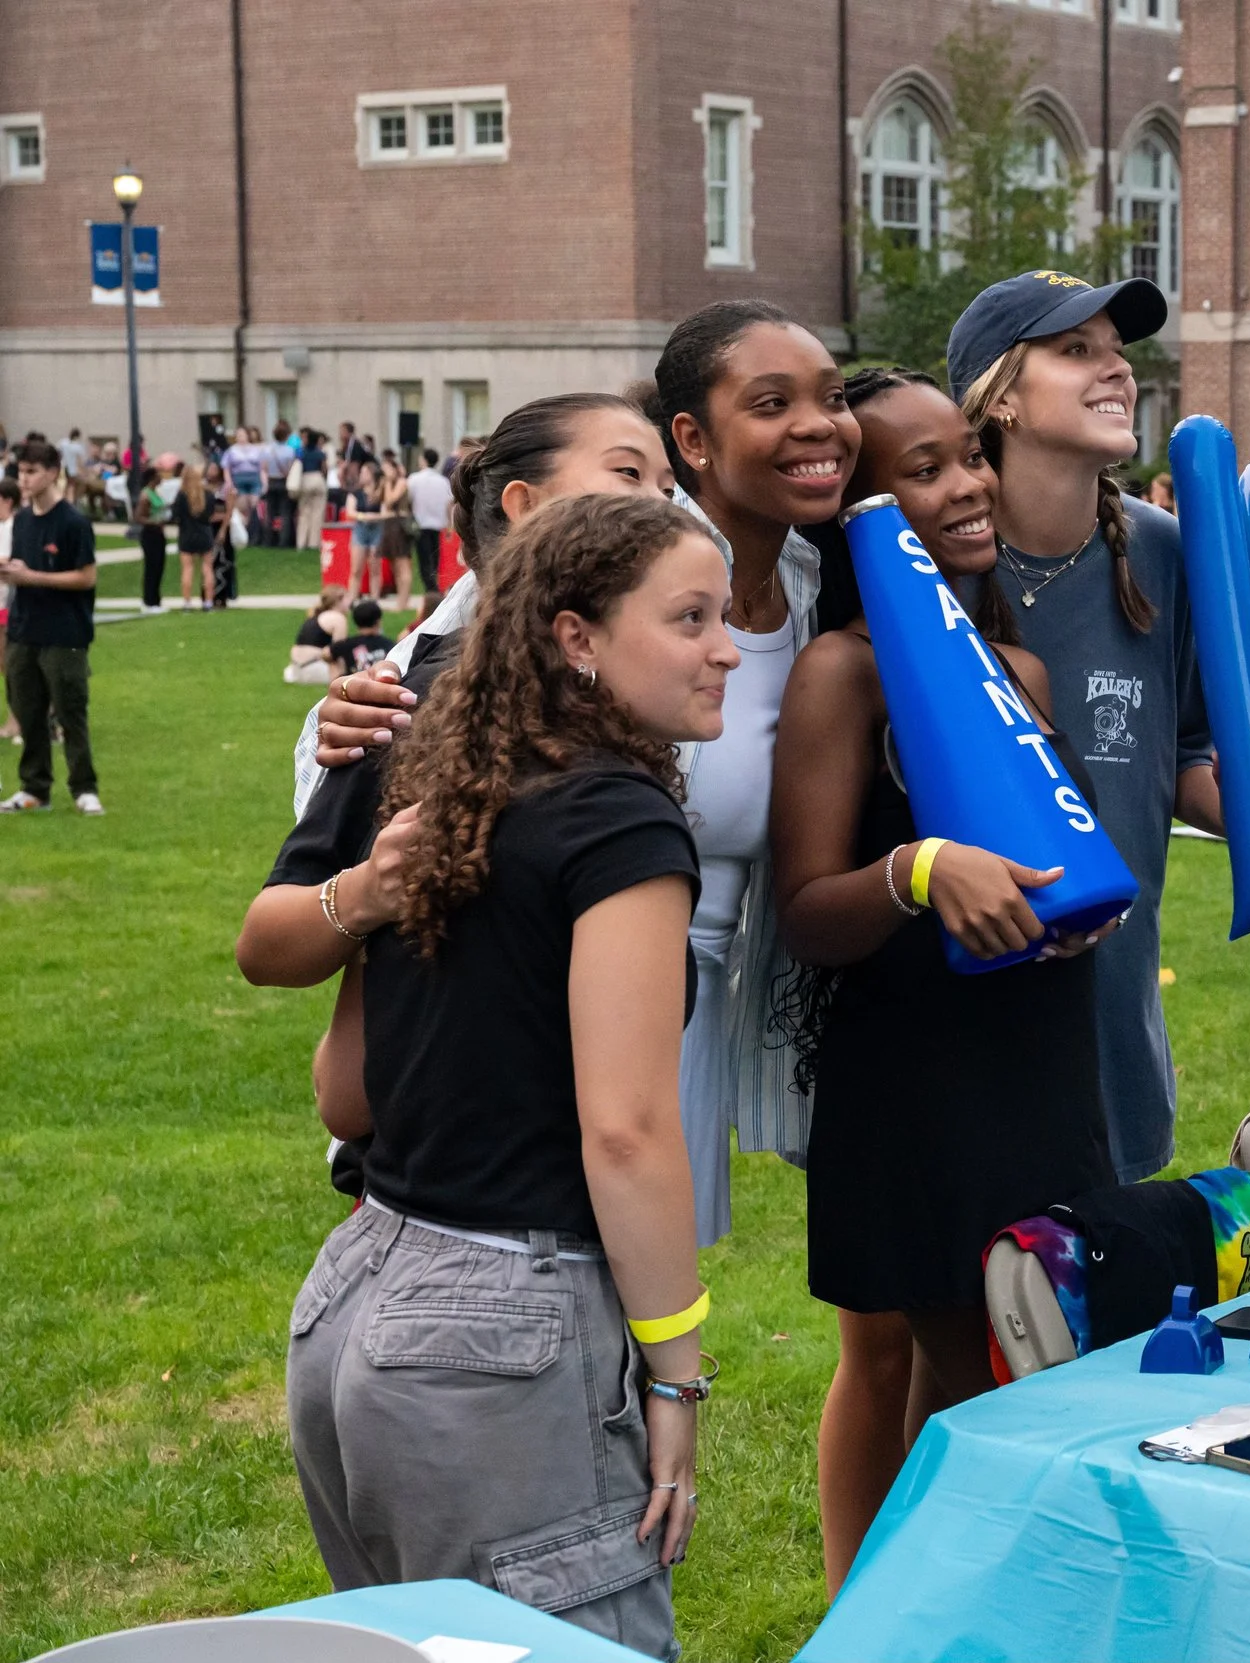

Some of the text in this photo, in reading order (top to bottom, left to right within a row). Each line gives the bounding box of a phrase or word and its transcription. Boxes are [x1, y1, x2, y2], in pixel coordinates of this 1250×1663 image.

[898, 528, 1096, 833] SAINTS
[1105, 670, 1117, 678] INTO
[1086, 676, 1143, 709] KALER'S
